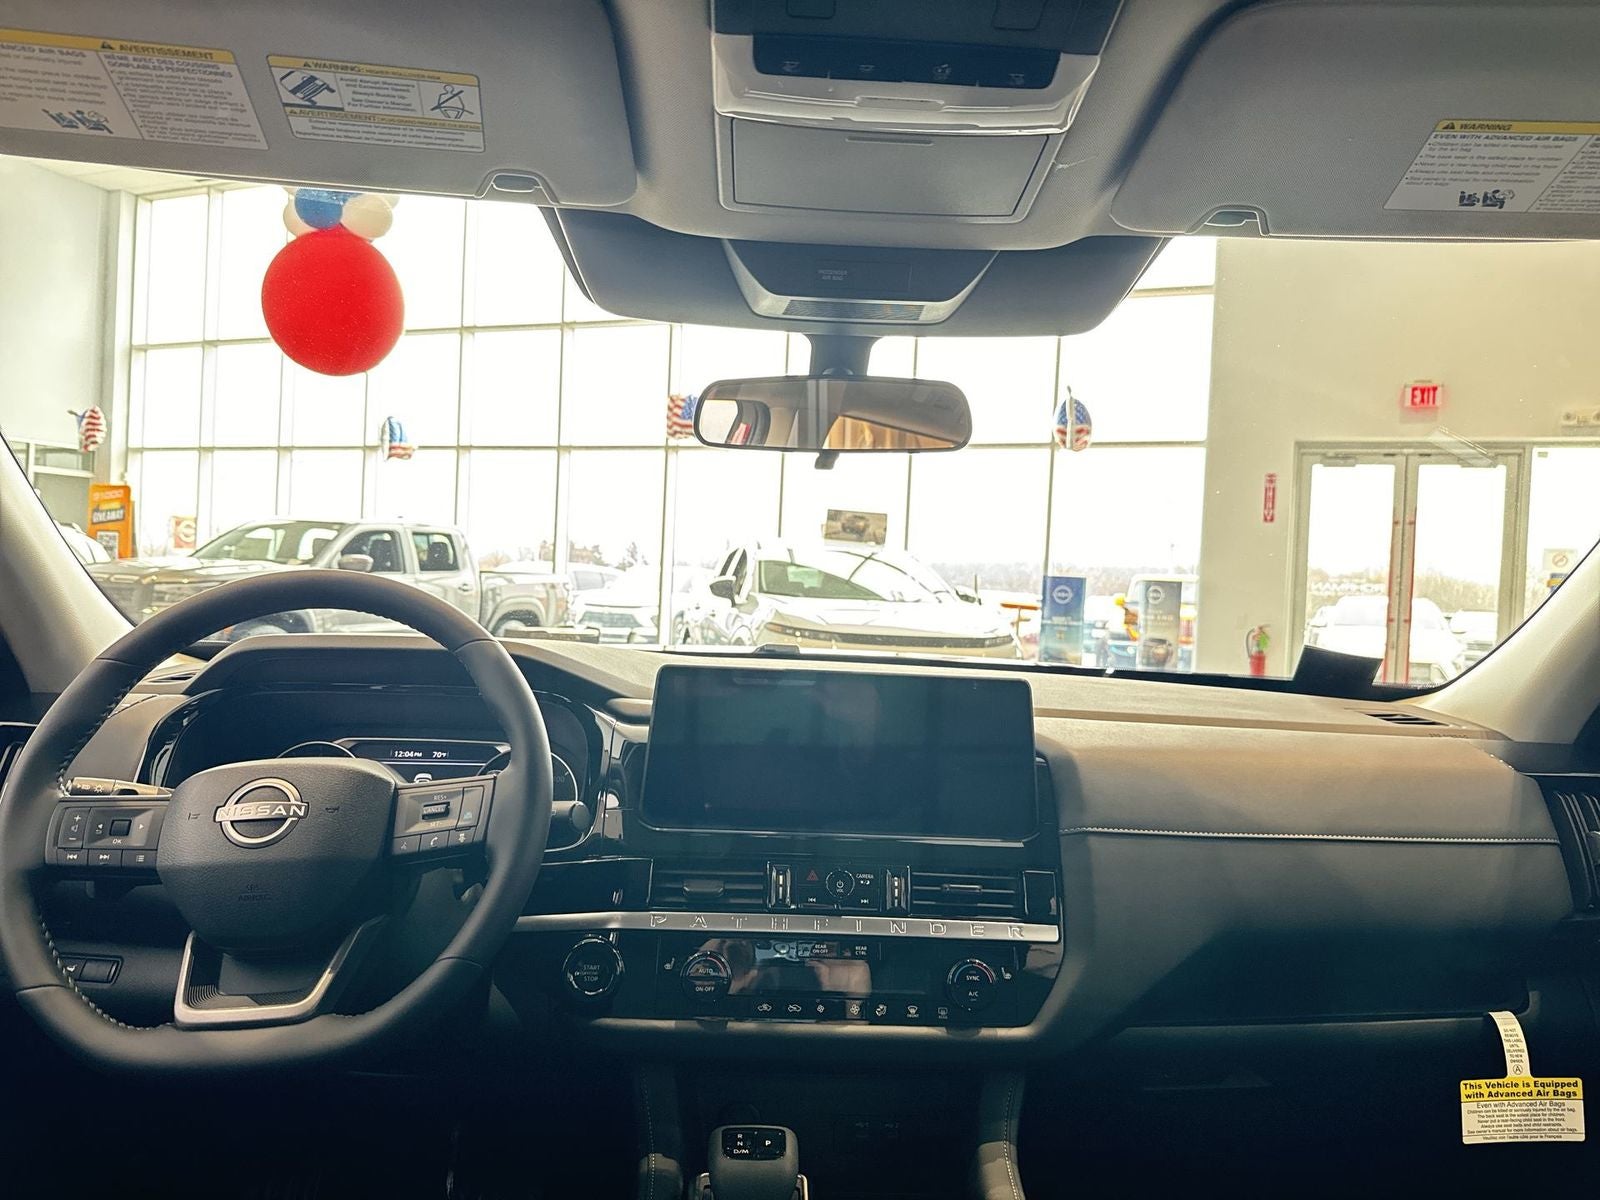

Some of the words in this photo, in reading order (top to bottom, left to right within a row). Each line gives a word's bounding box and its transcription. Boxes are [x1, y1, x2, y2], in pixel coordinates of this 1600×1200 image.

[1411, 386, 1438, 406] EXIT
[219, 804, 305, 819] NISSAN
[649, 914, 1025, 940] PATHFINDER
[1462, 1083, 1482, 1091] This
[1484, 1081, 1519, 1090] Vehicle
[1534, 1080, 1578, 1090] Equipped
[1464, 1091, 1485, 1100] with
[1487, 1090, 1533, 1098] Advanced
[1536, 1090, 1550, 1098] Air
[1552, 1090, 1577, 1099] Bags
[1549, 1100, 1566, 1108] Bags
